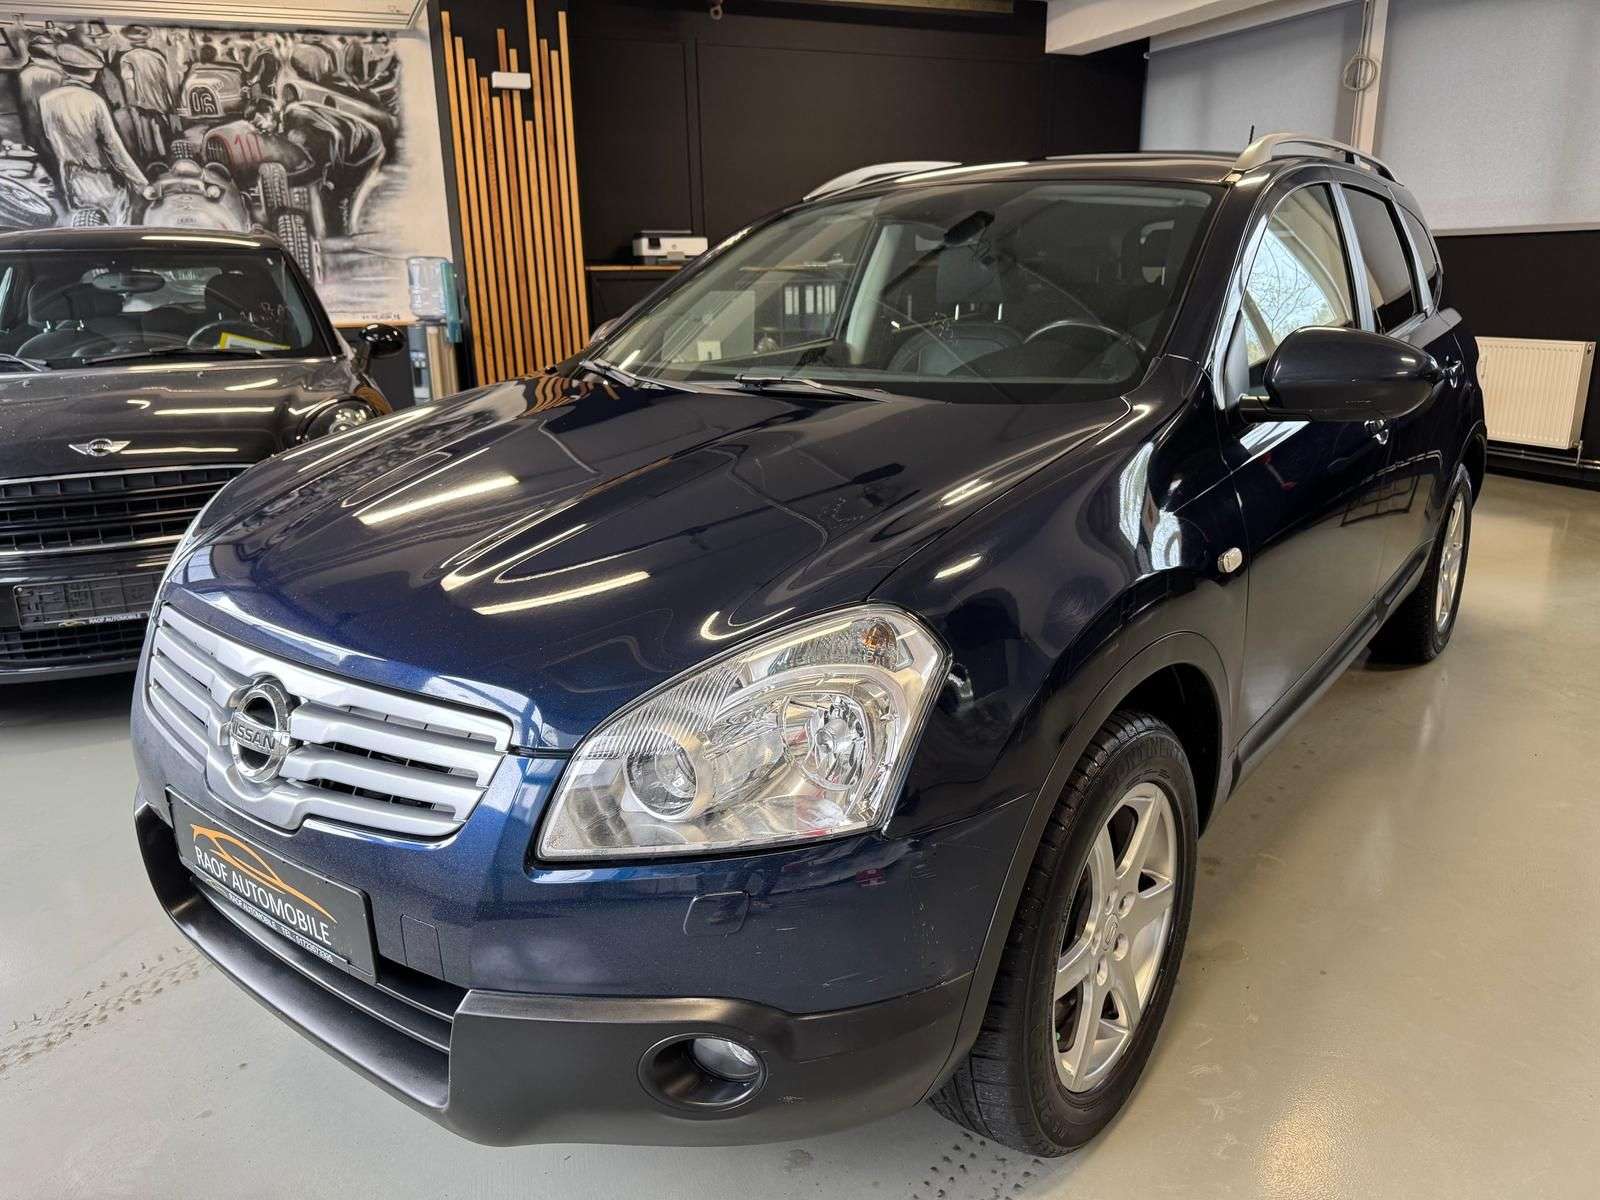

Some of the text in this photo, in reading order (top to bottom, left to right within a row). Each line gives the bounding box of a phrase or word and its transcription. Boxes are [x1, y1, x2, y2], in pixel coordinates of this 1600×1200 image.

[232, 720, 276, 750] NISSAN
[194, 844, 332, 946] RAOF AUTOMOBILE
